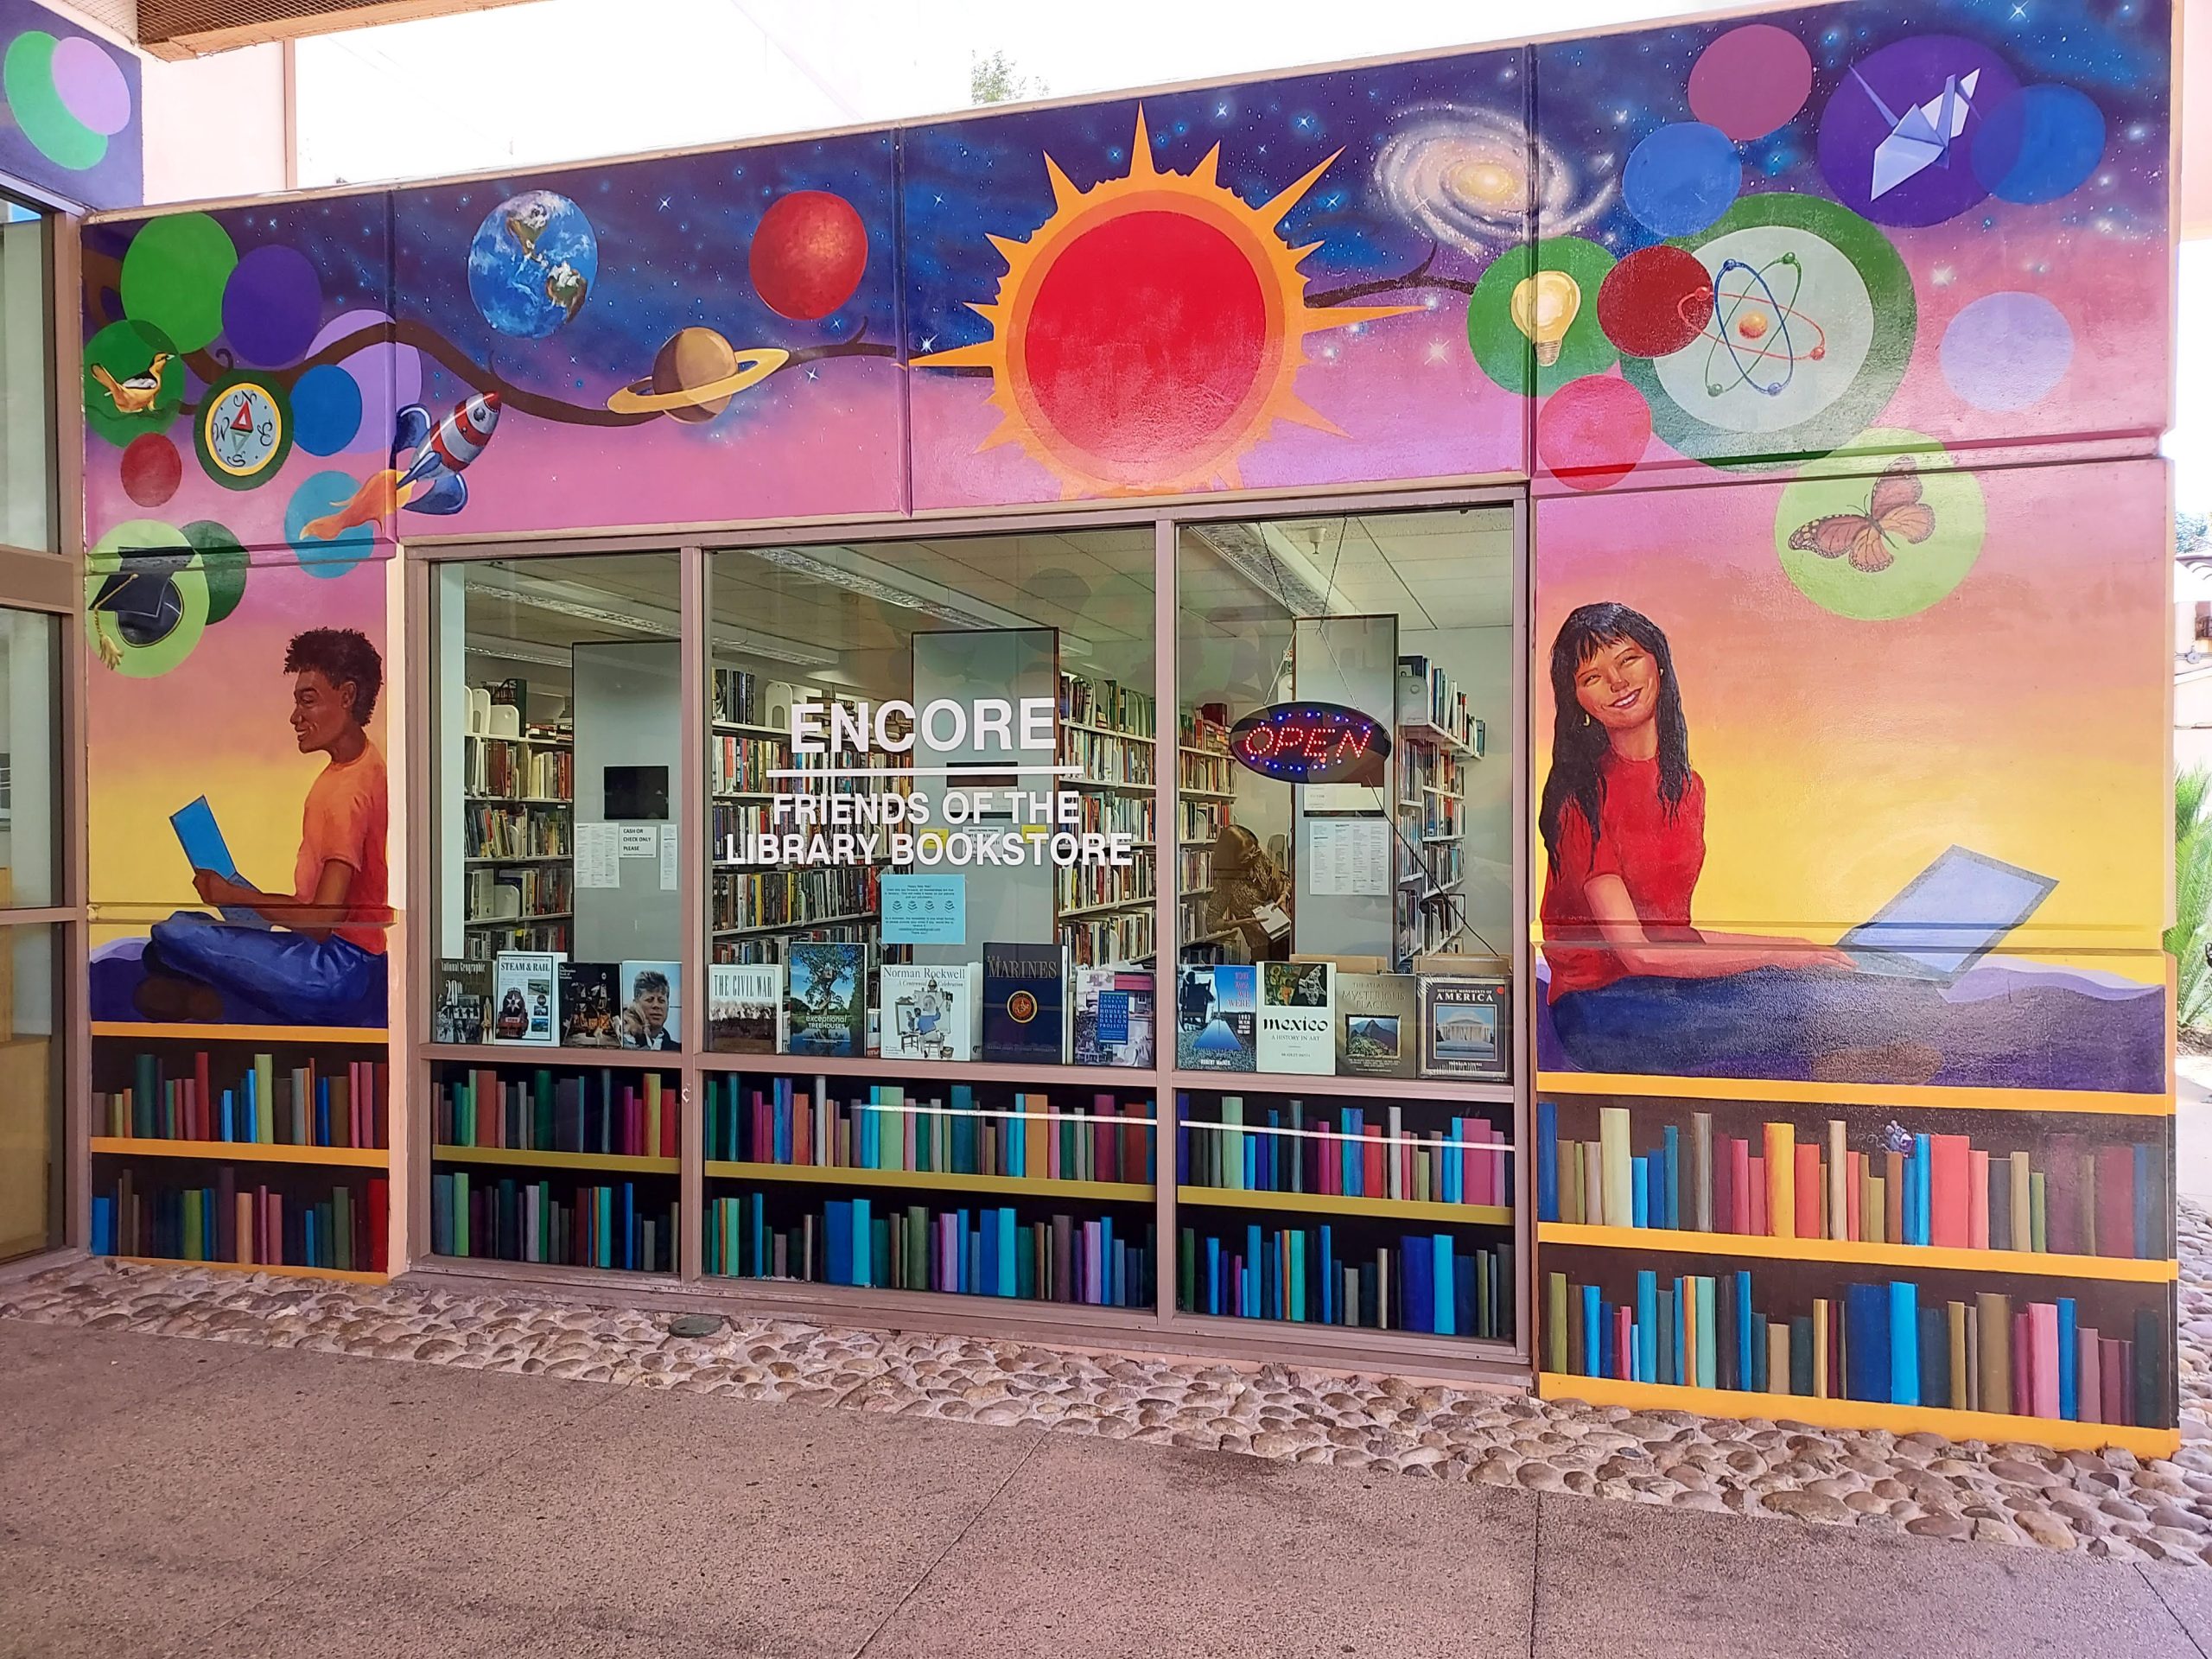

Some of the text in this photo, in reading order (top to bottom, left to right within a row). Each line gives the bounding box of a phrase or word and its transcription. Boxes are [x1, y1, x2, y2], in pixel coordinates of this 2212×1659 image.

[791, 697, 1057, 753] ENCORE
[1246, 726, 1371, 759] OPEN
[773, 791, 1080, 825] FRIENDS OF THE
[727, 833, 880, 865] LIBRARY
[891, 832, 1133, 866] BOOKSTORE
[460, 962, 486, 975] Geographic
[501, 962, 550, 972] STEAM & RAIL
[883, 966, 965, 979] Norman Rockwell
[987, 960, 1058, 979] MARINES
[714, 975, 772, 998] THE CIVIL WAR
[1342, 990, 1406, 1001] MYSTERIOUS
[1436, 993, 1494, 1002] AMERICA
[1228, 999, 1251, 1007] WERE
[1356, 1000, 1391, 1010] PLACES
[805, 1014, 847, 1023] exceptional
[1263, 1016, 1328, 1032] mexico
